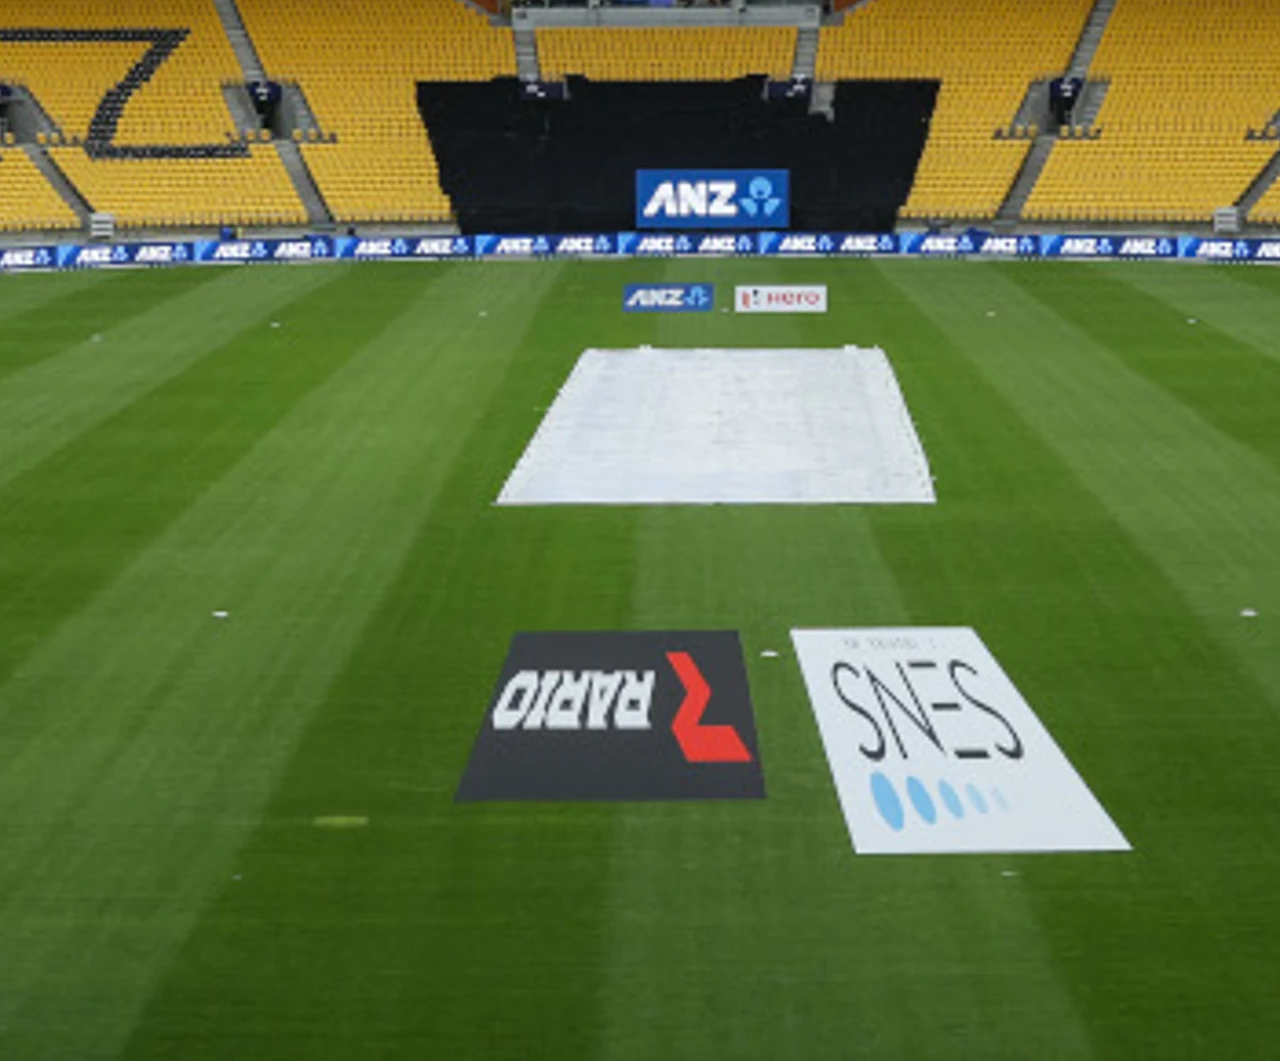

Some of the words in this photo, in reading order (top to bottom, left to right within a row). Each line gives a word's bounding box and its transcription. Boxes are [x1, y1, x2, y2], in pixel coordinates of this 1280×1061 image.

[643, 180, 739, 217] ANZ
[214, 242, 250, 258] ANZ
[275, 242, 311, 258] ANZ
[355, 240, 392, 255] ANZ
[416, 239, 452, 254] ANZ
[496, 238, 532, 253] ANZ
[557, 237, 593, 252] ANZ
[638, 237, 674, 251] ANZ
[698, 237, 735, 251] ANZ
[779, 236, 816, 251] ANZ
[840, 236, 878, 251] ANZ
[921, 237, 957, 251] ANZ
[981, 238, 1017, 253] ANZ
[1061, 238, 1097, 254] ANZ
[1120, 239, 1156, 254] ANZ
[1197, 242, 1233, 257] ANZ
[0, 250, 36, 266] ANZ
[76, 247, 111, 263] ANZ
[135, 246, 170, 261] ANZ
[626, 288, 685, 307] ANZ
[492, 670, 656, 730] RARIO
